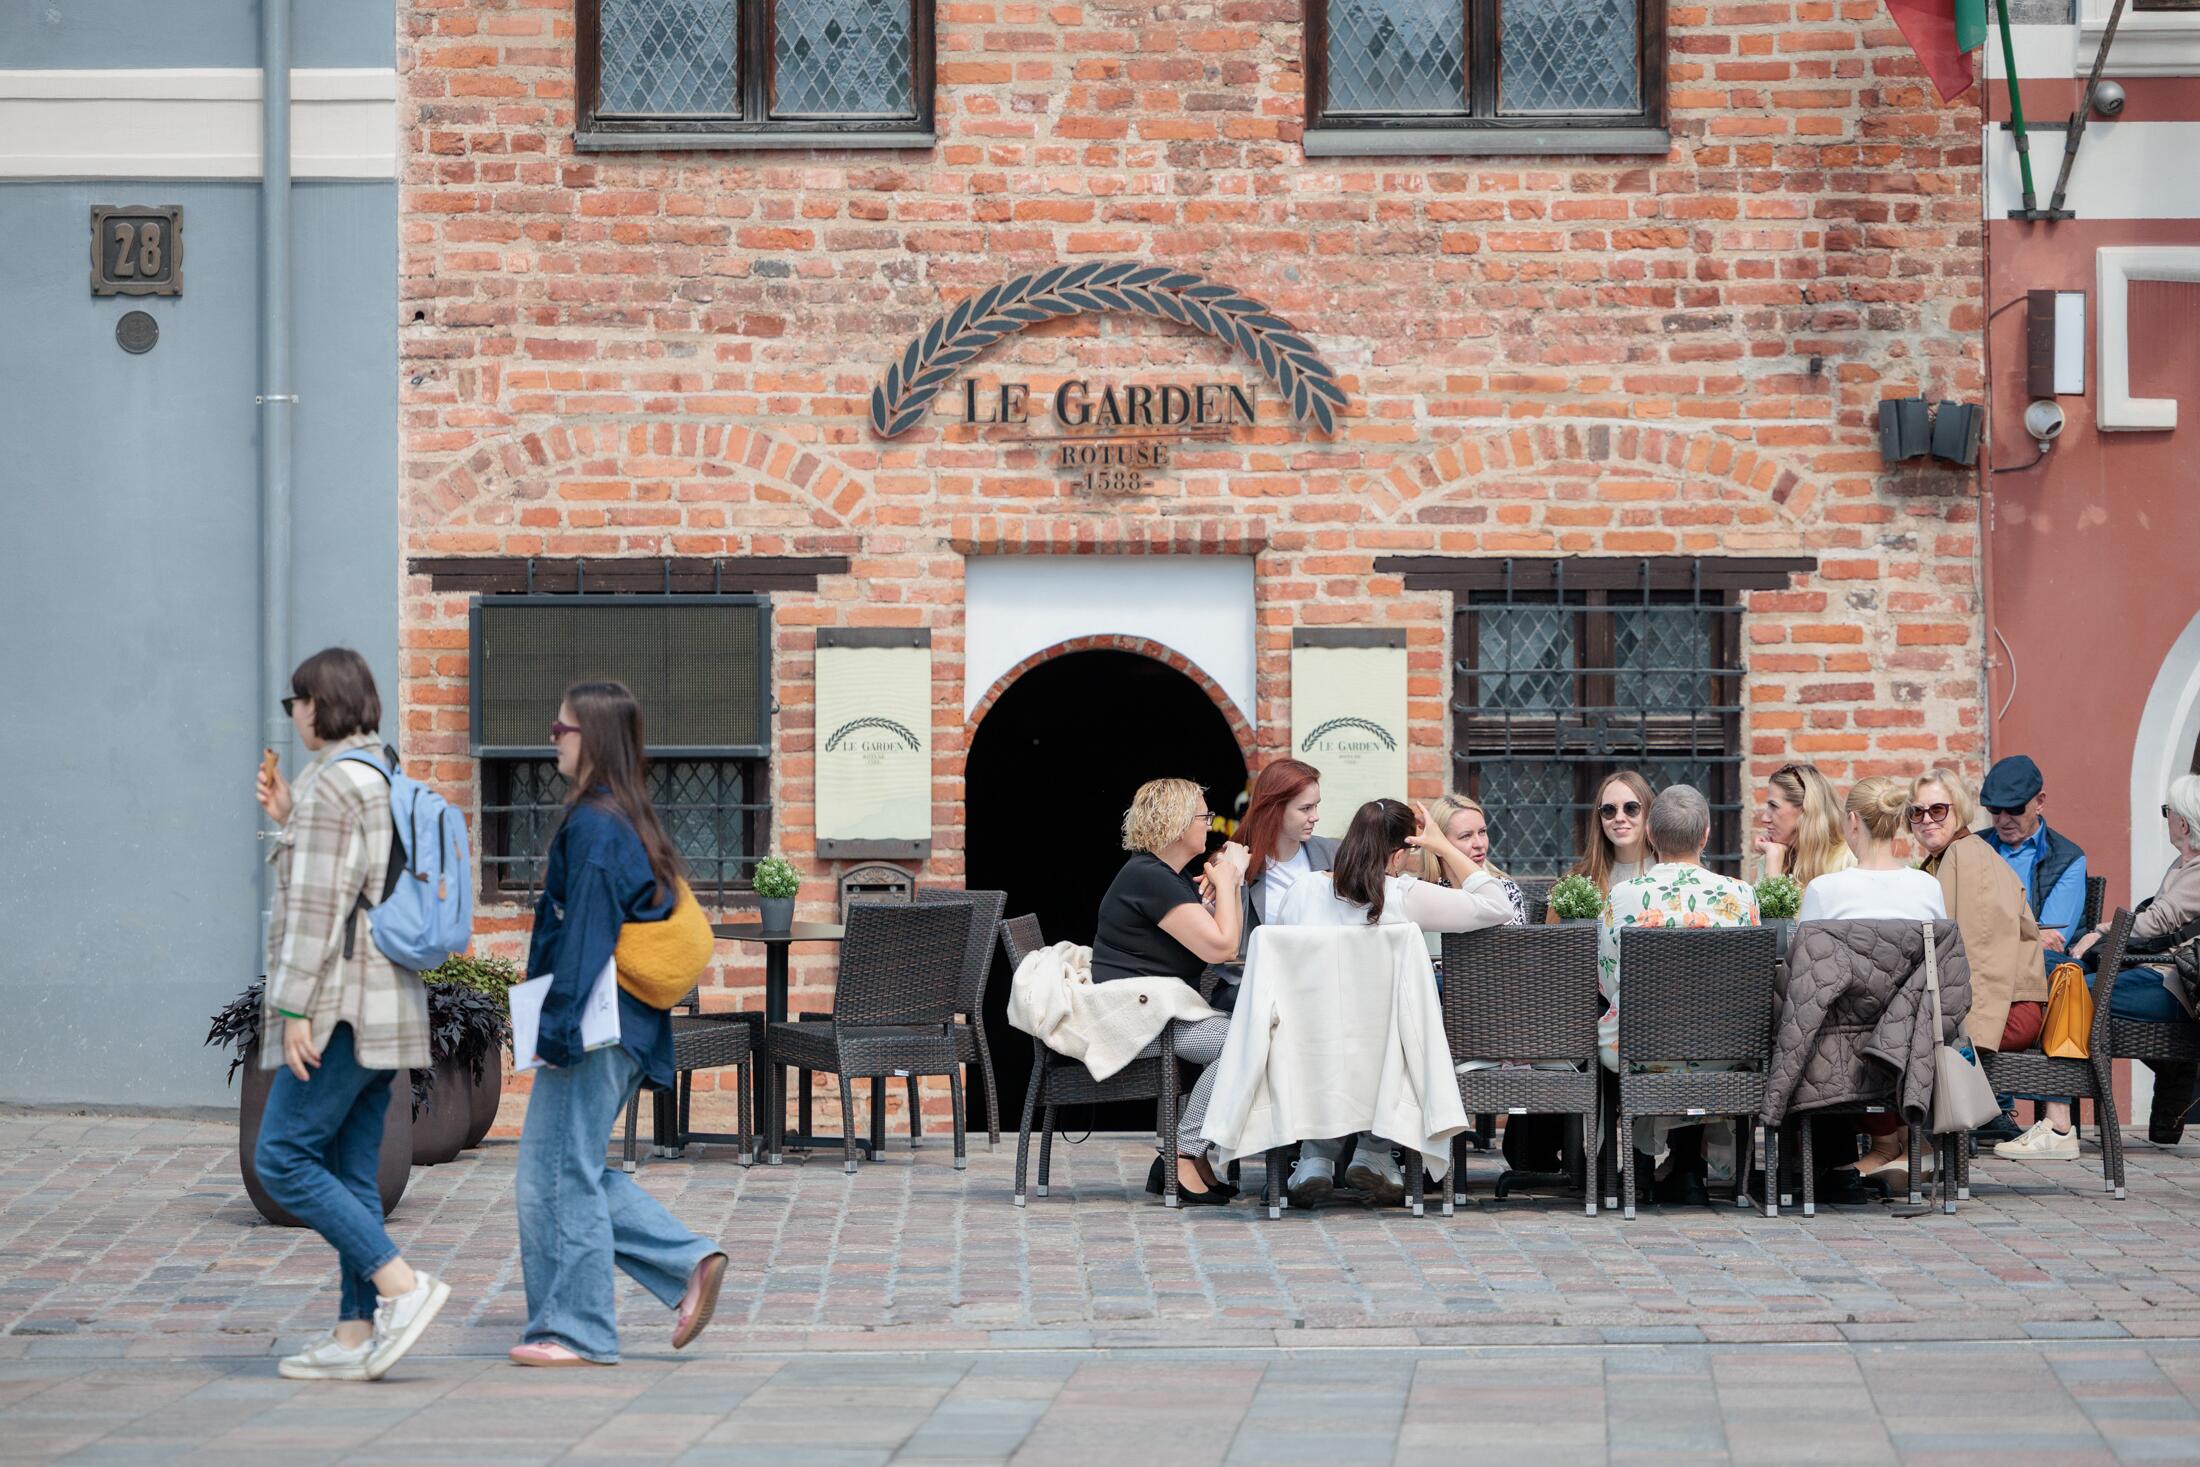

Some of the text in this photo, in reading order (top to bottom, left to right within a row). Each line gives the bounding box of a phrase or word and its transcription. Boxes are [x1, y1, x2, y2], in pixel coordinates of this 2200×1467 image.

[114, 222, 161, 277] 28
[961, 378, 1257, 426] LE GARDEN
[843, 741, 904, 752] LE GARDEN
[1338, 741, 1380, 752] GARDEN
